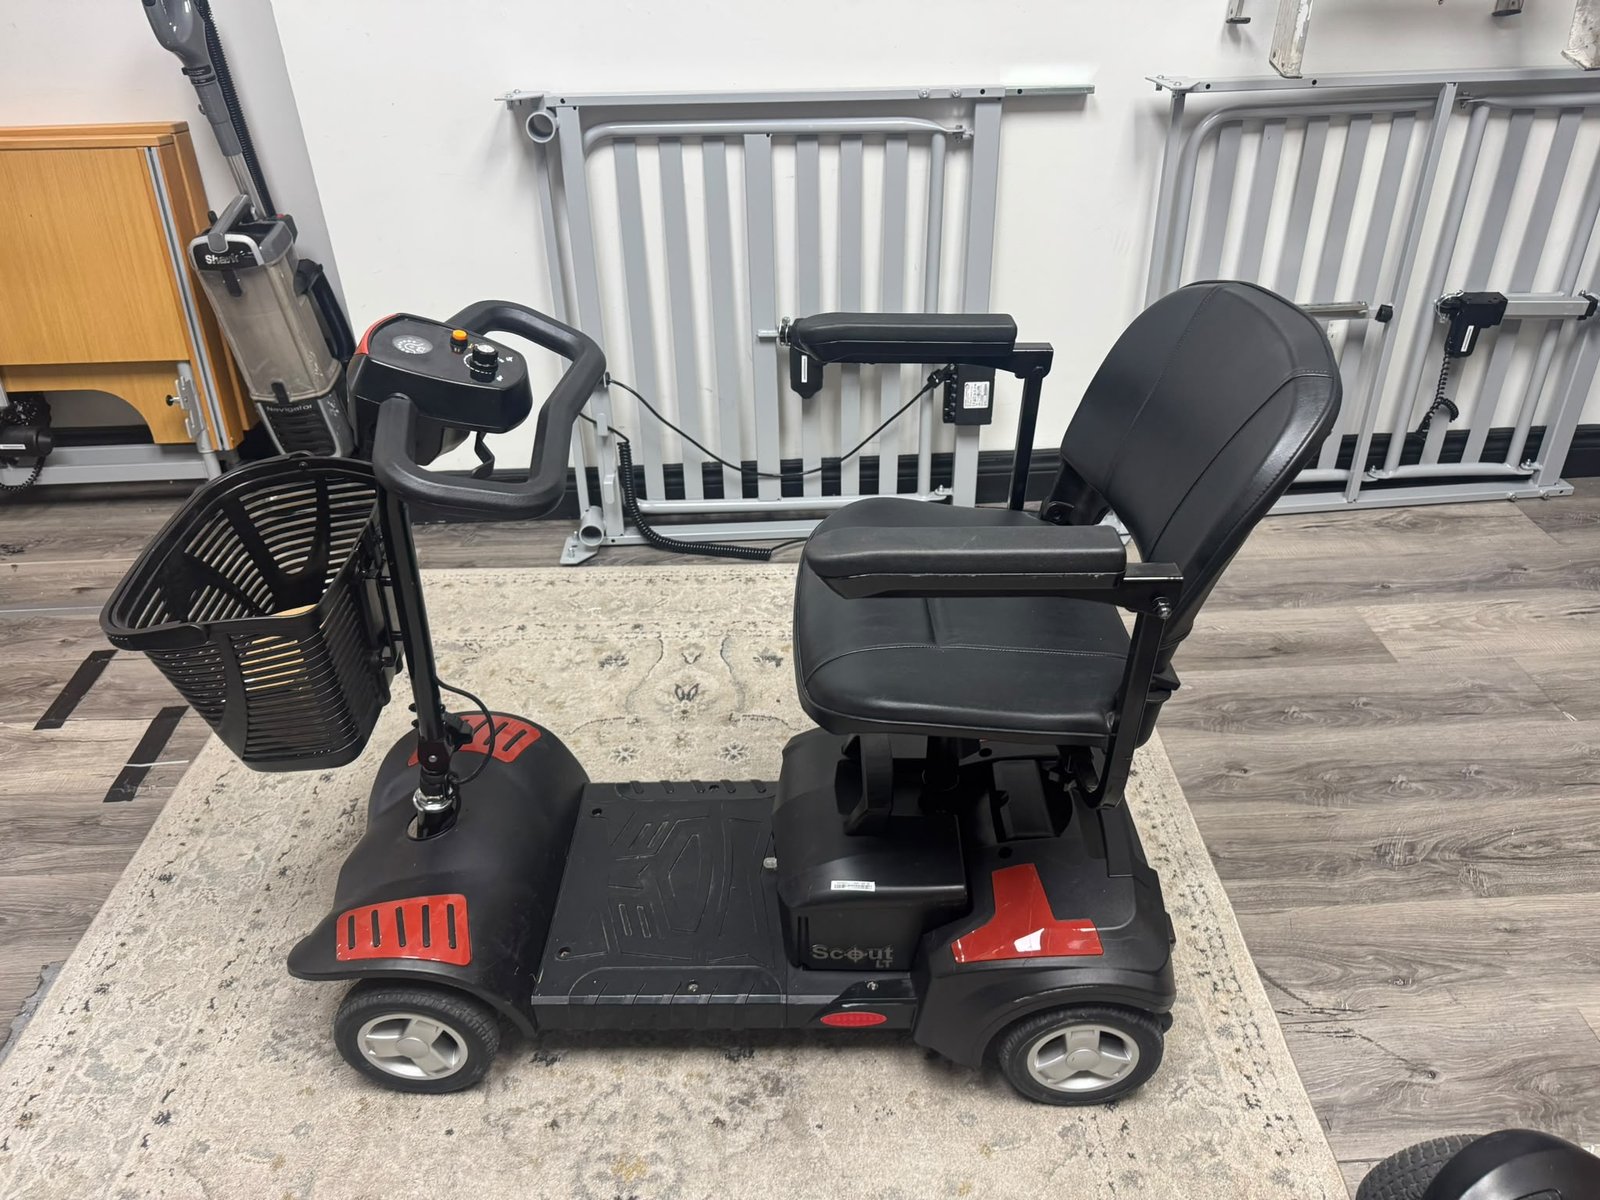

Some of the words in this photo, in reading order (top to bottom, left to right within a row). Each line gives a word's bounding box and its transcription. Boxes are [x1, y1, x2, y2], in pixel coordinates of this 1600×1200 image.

[204, 253, 239, 265] Shark
[266, 404, 312, 413] Navigator
[811, 944, 894, 963] Scout
[875, 960, 893, 969] LT
